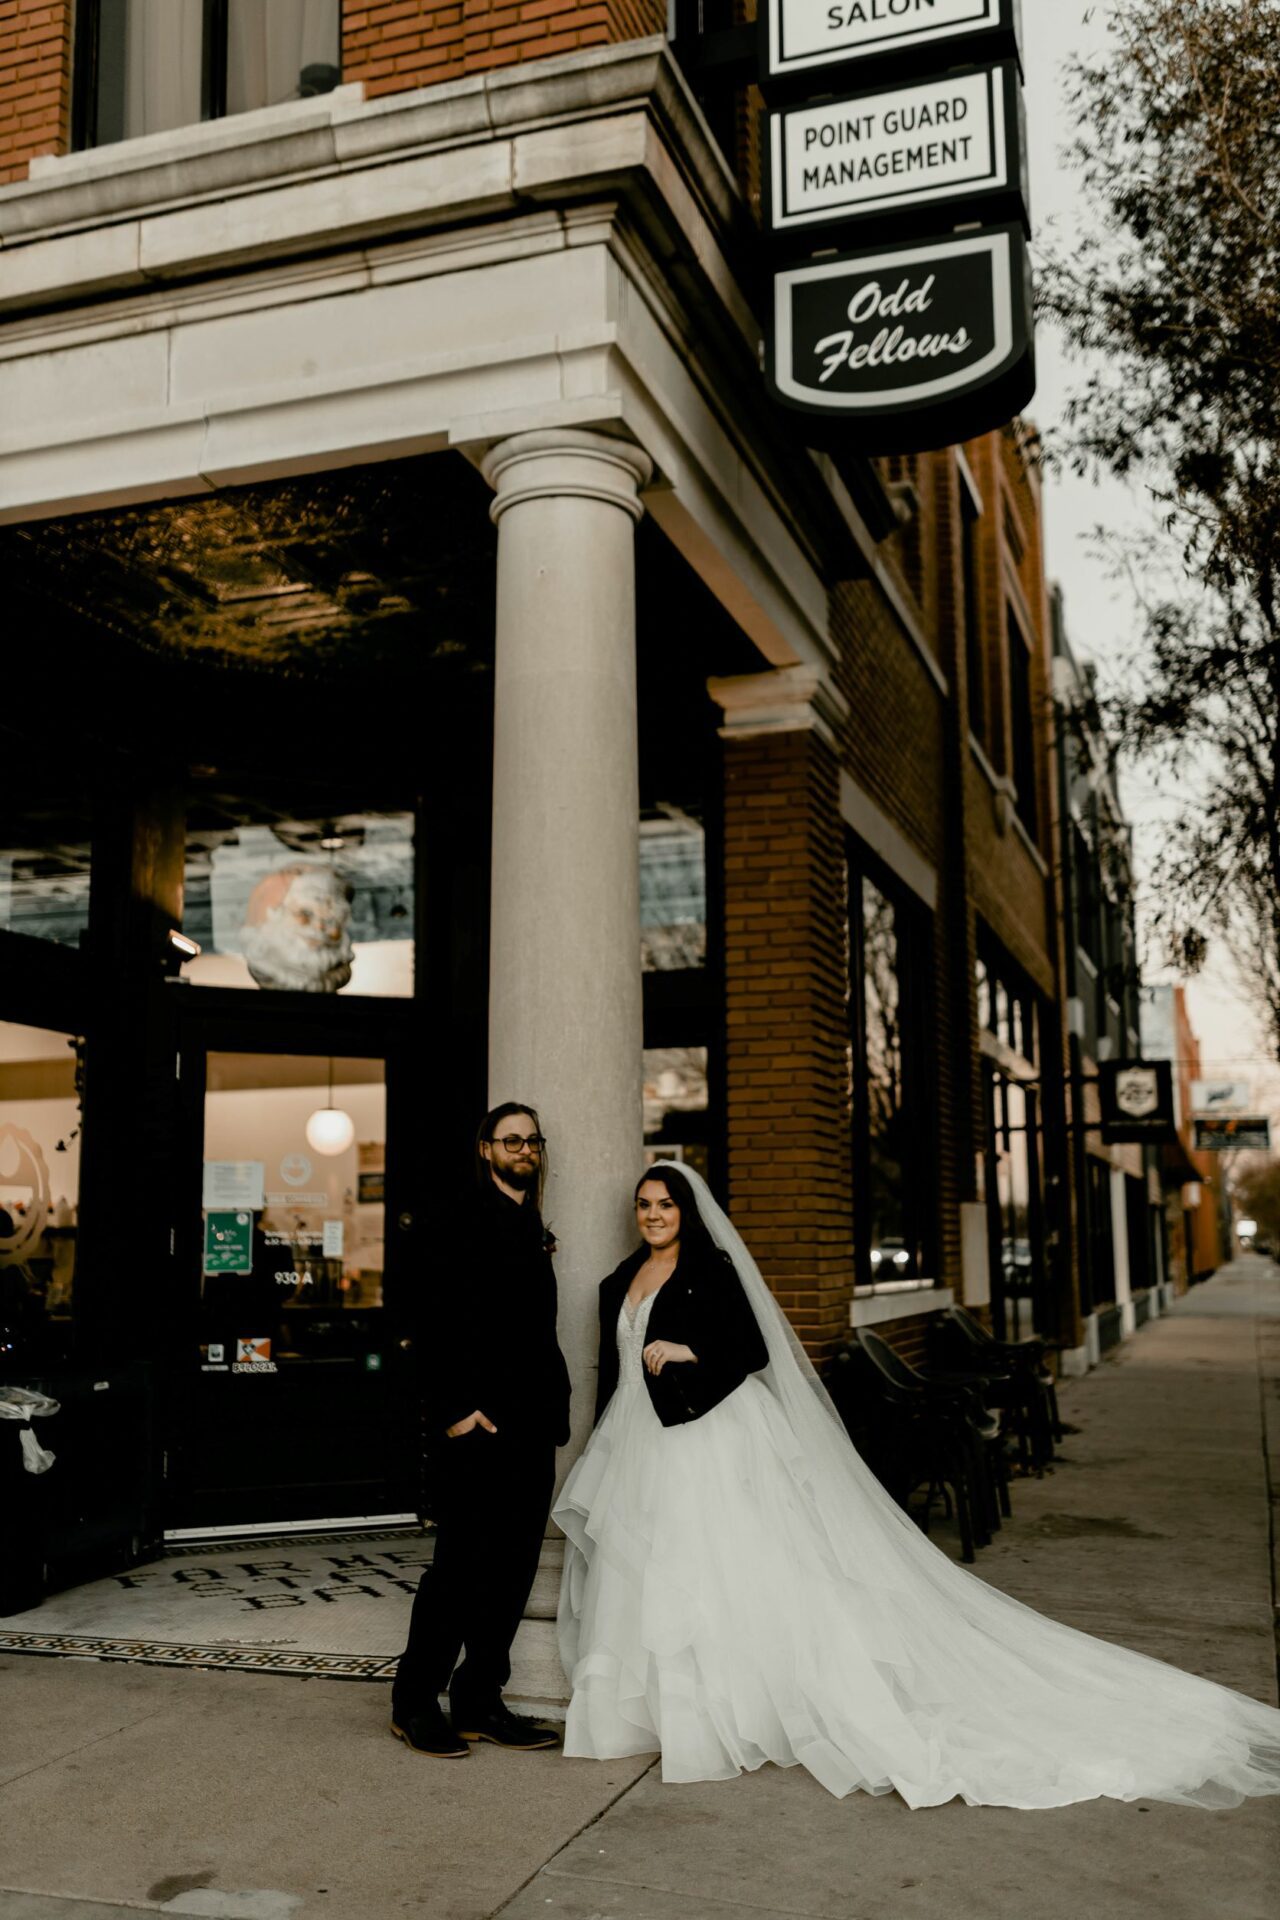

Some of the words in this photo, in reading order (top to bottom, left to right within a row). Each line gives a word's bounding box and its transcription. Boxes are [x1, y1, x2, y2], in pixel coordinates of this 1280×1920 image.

[804, 115, 876, 152] POINT
[883, 97, 968, 136] GUARD
[803, 136, 973, 192] MANAGEMENT
[847, 274, 936, 324] Odd
[814, 326, 973, 383] Fellows
[274, 1272, 300, 1285] 930
[302, 1272, 314, 1285] A
[112, 1551, 432, 1590] FARME
[189, 1564, 433, 1598] STAT
[232, 1581, 421, 1611] BAN
